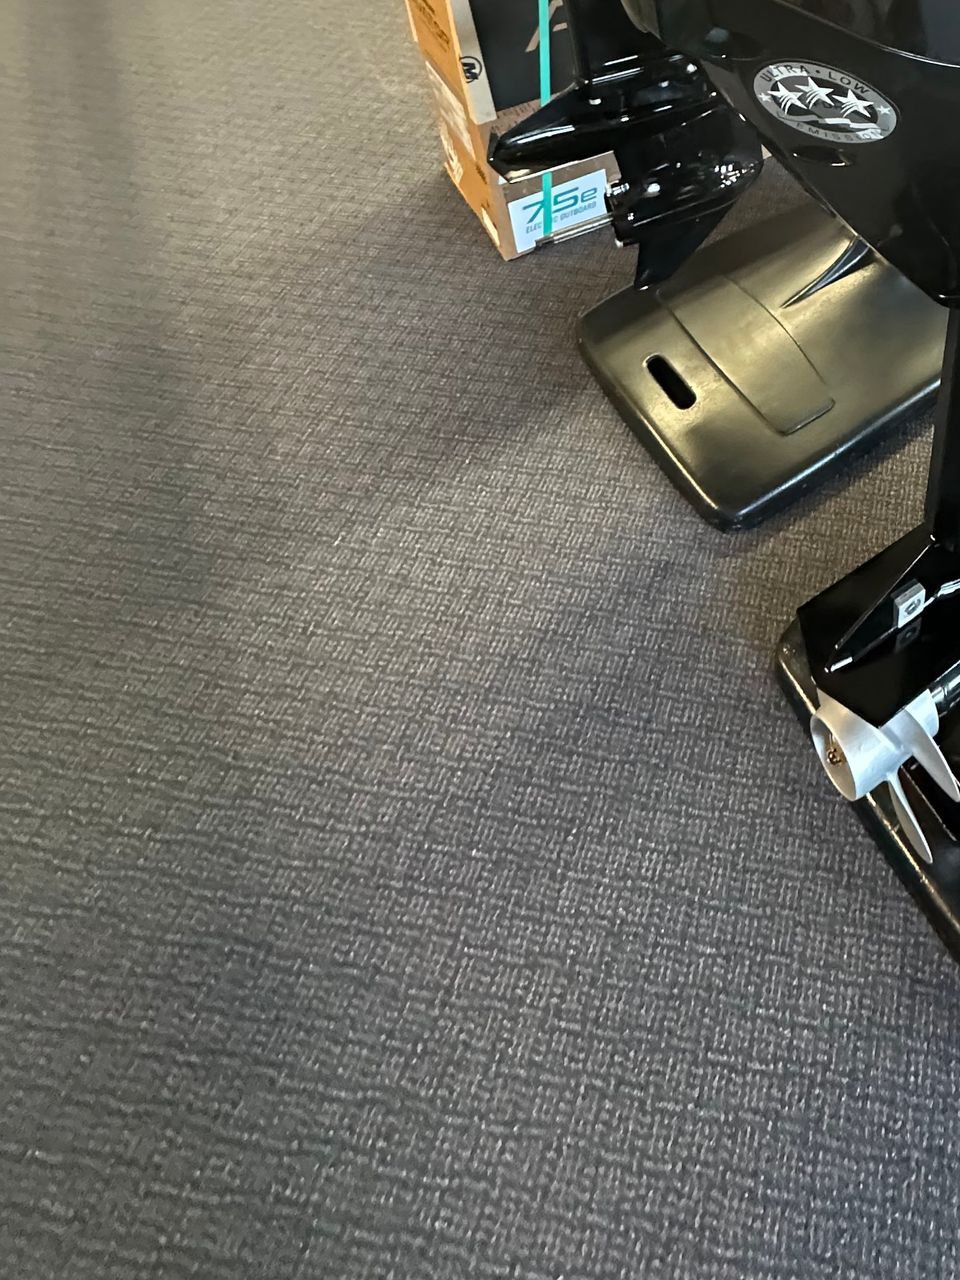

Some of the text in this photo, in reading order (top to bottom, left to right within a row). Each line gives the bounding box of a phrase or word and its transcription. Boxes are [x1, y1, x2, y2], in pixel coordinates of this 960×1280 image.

[760, 64, 871, 94] ULTRA LOW
[525, 215, 558, 233] ELECC
